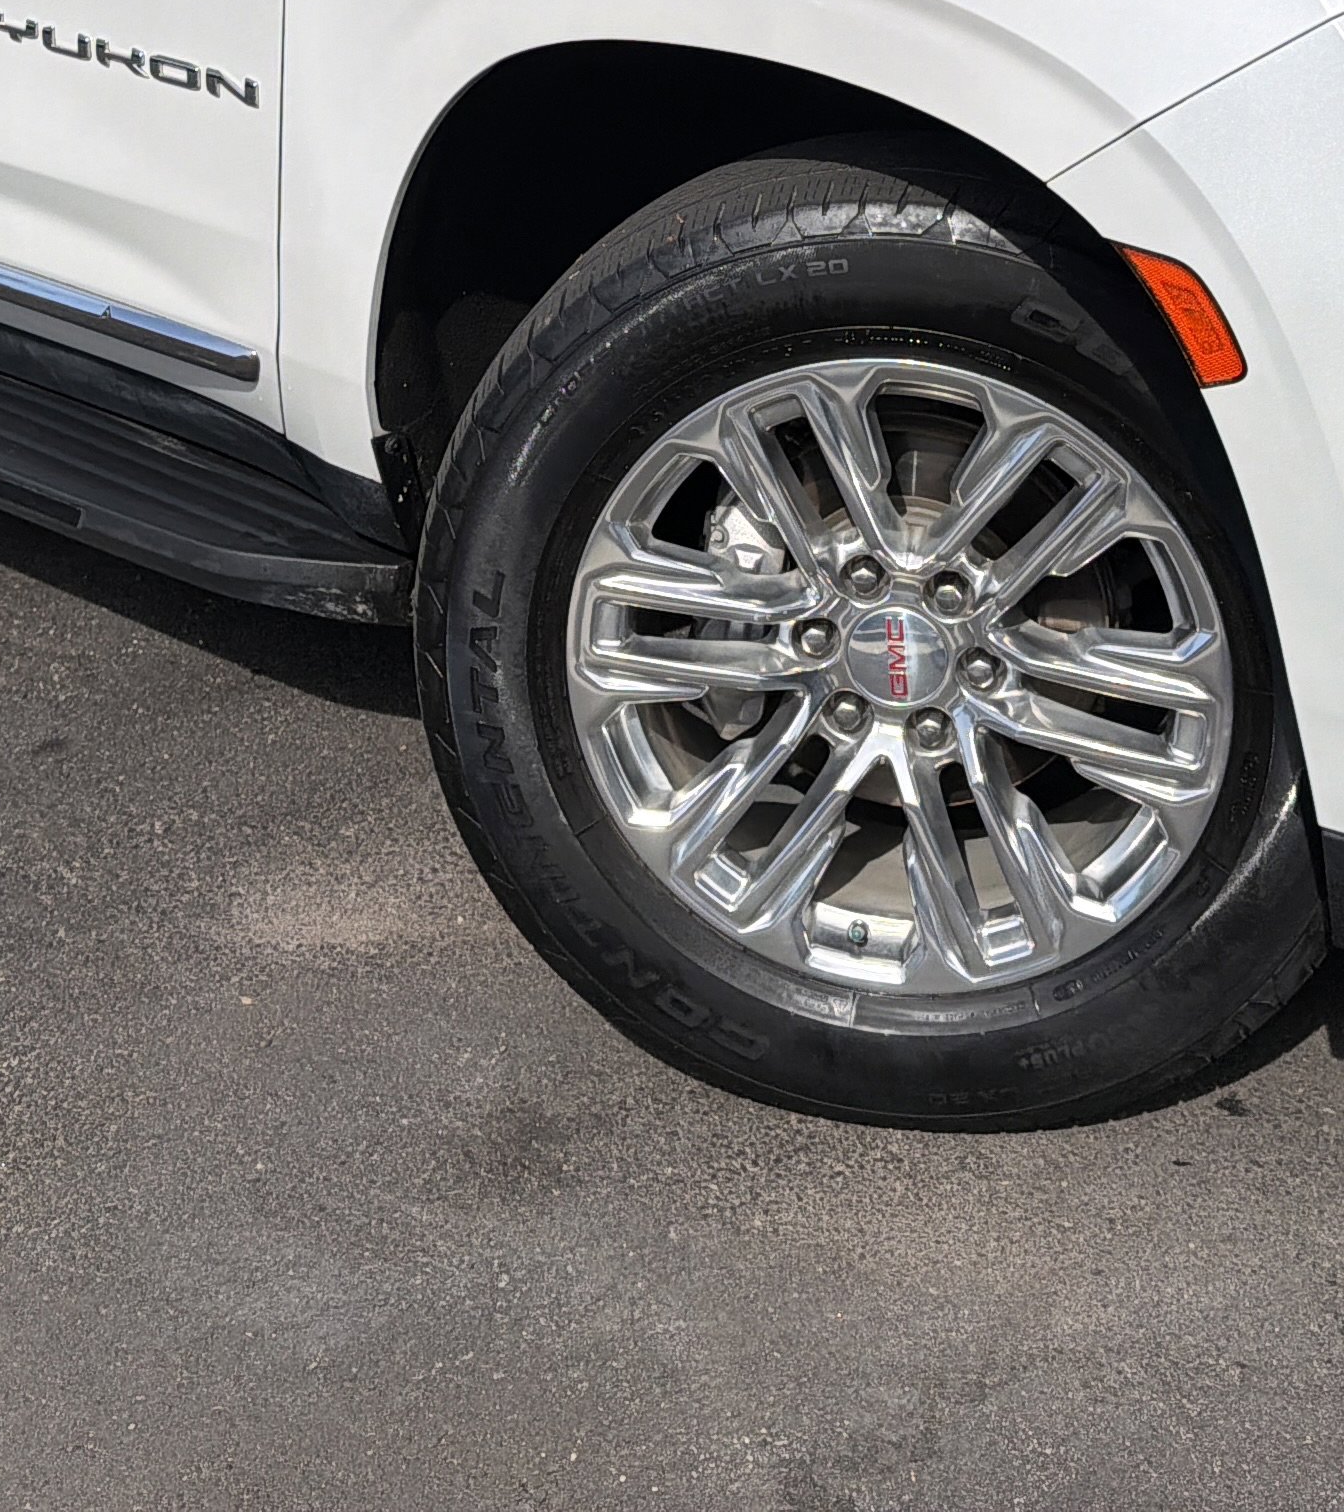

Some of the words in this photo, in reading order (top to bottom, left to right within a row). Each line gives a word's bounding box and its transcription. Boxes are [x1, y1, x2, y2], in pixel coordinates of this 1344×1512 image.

[755, 263, 799, 286] LX
[806, 258, 850, 277] 20
[885, 616, 909, 697] GMC
